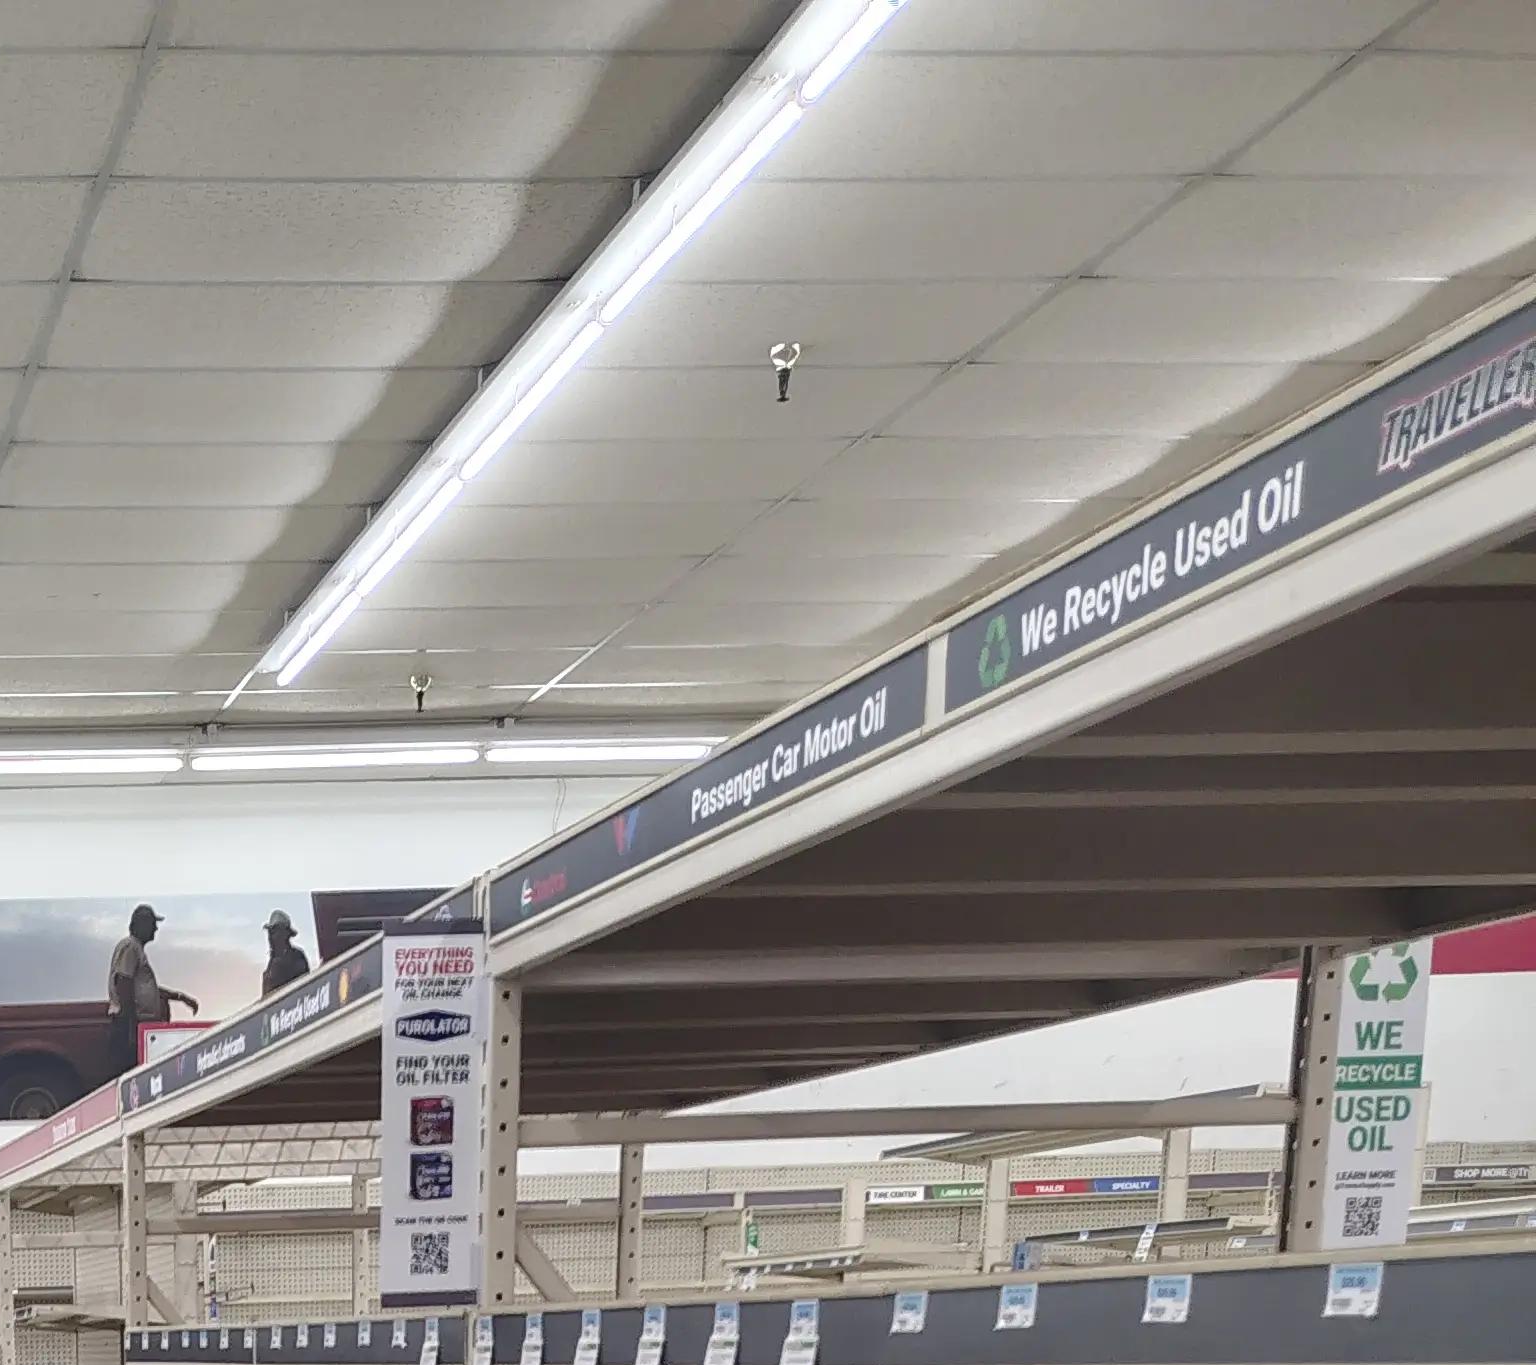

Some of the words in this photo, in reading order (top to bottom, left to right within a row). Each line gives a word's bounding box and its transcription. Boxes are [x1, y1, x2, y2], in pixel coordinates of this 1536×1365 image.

[1021, 604, 1057, 656] We
[1063, 543, 1167, 635] Recycle
[1174, 488, 1251, 577] Used
[1257, 461, 1304, 534] Oil
[691, 758, 769, 825] Passenger
[771, 742, 801, 783] Car
[803, 713, 857, 769] Motor
[859, 686, 887, 738] Oil
[395, 947, 474, 960] EVERYTHING
[395, 960, 428, 976] YOU
[431, 959, 474, 975] NEED
[397, 1018, 468, 1036] PUROLATOR
[1355, 1020, 1404, 1050] WE
[396, 1055, 428, 1069] FIND
[431, 1054, 471, 1068] YOUR
[396, 1072, 420, 1086] OIL
[423, 1070, 471, 1085] FILTER
[1335, 1062, 1418, 1083] RECYCLE
[1334, 1095, 1412, 1123] USED
[1348, 1126, 1393, 1152] OIL
[1336, 1171, 1366, 1181] LEARN
[1369, 1170, 1396, 1180] MORE
[1454, 1167, 1480, 1179] SHOP
[1481, 1167, 1508, 1177] MORE
[1035, 1184, 1065, 1193] TRAILER
[1112, 1181, 1151, 1190] SPECIALTY
